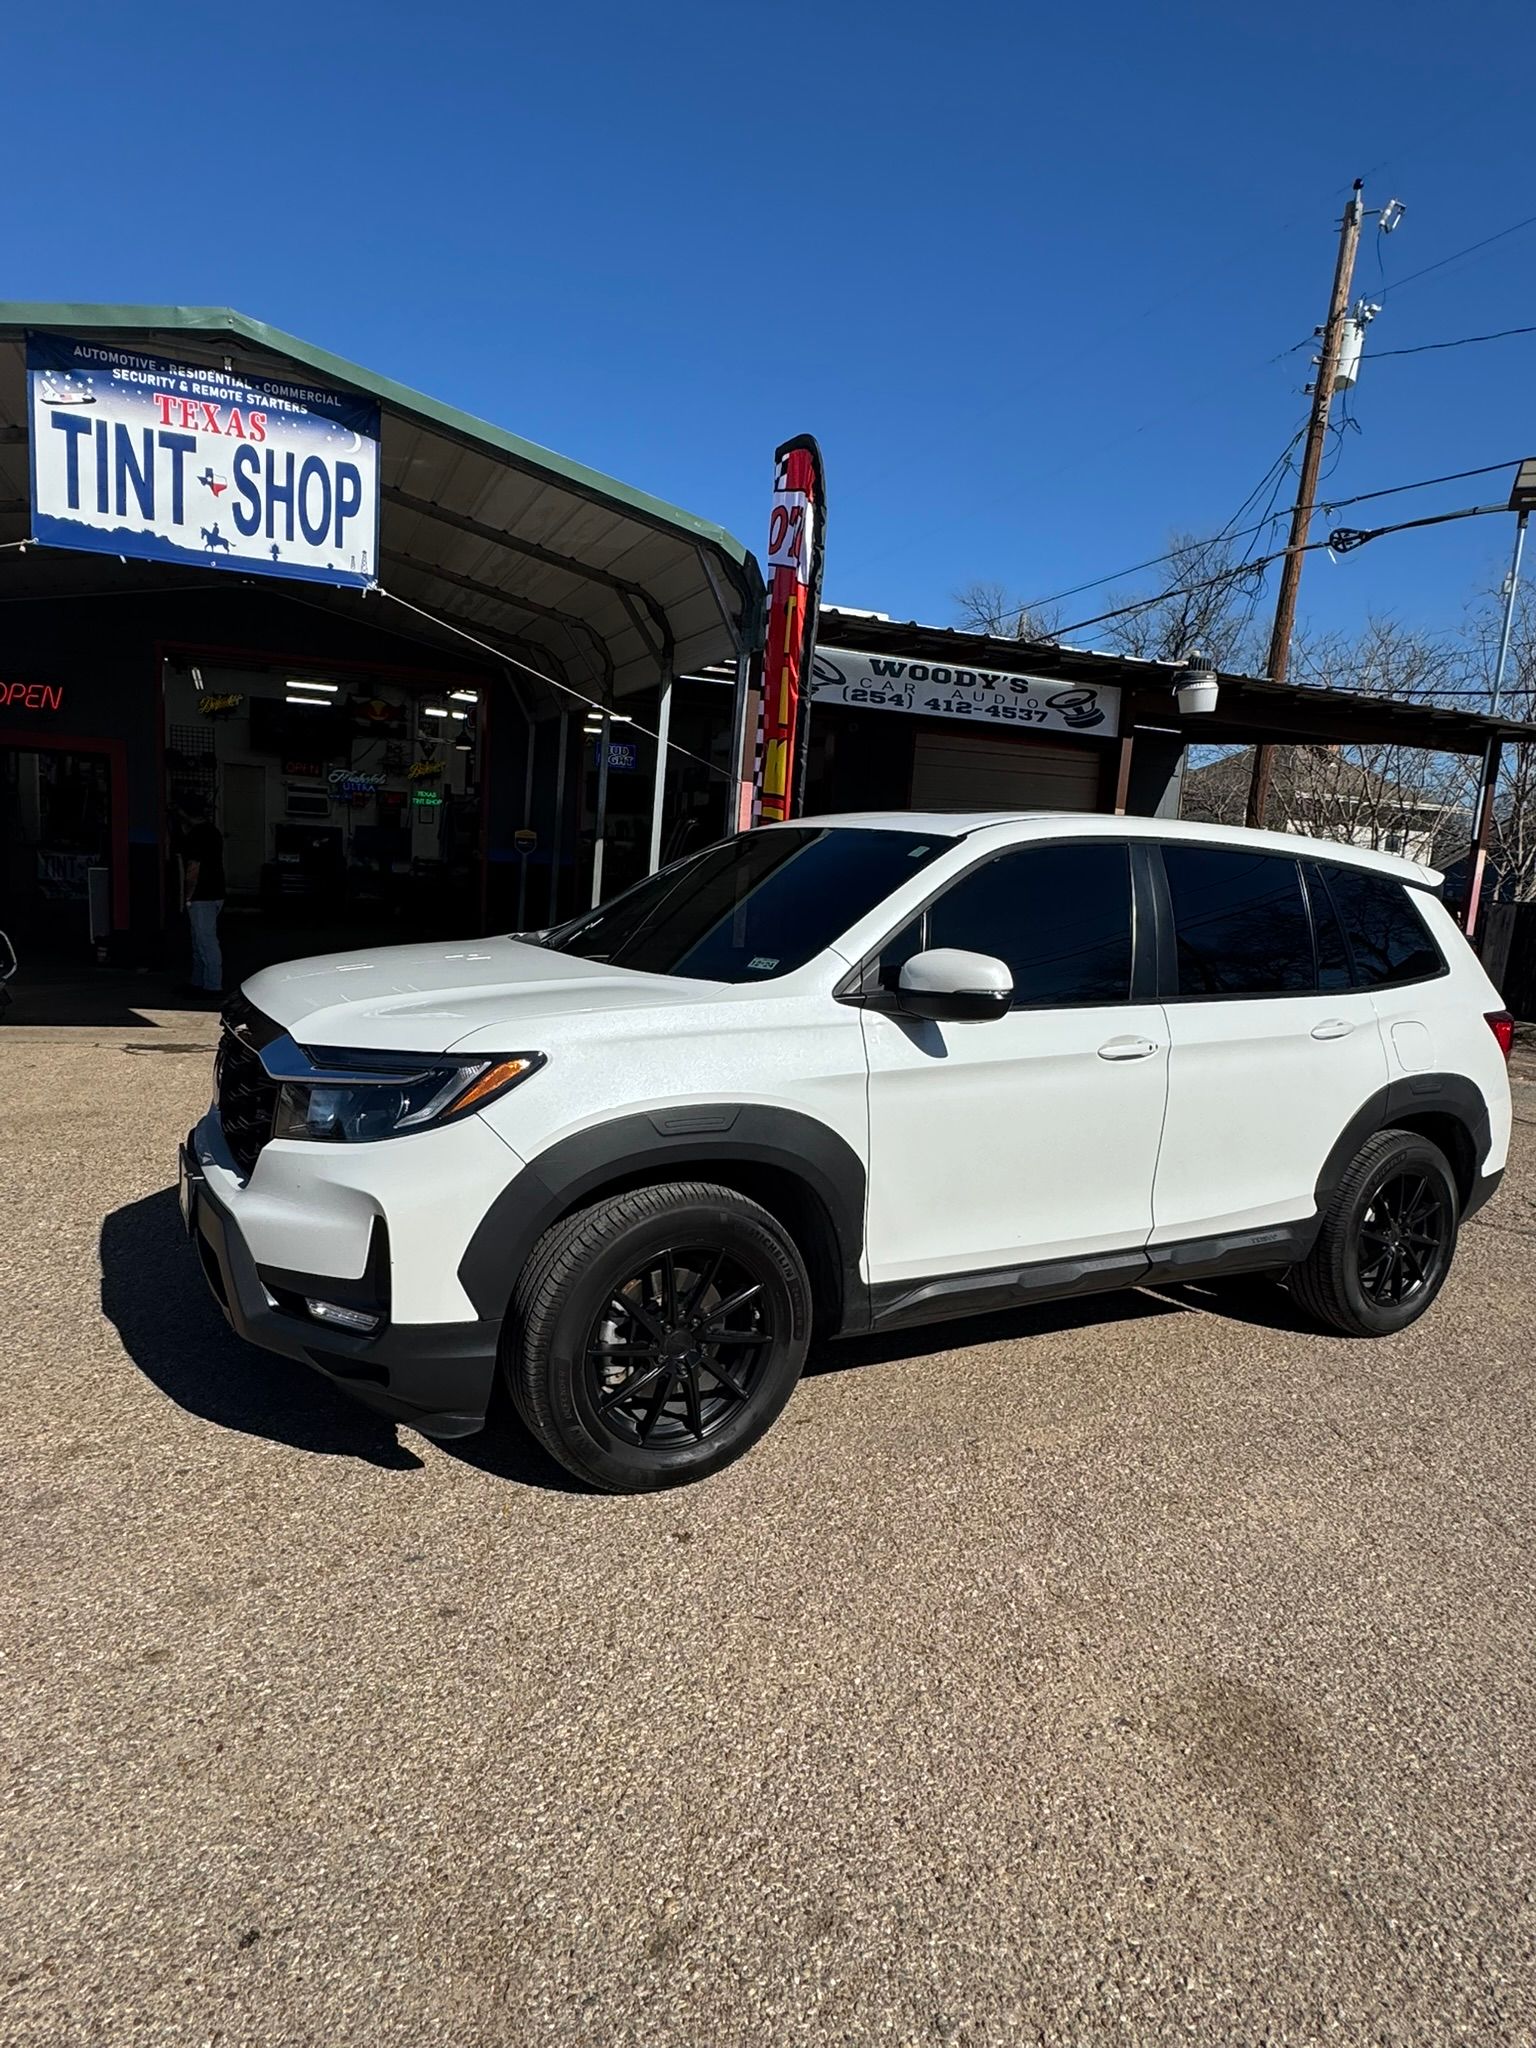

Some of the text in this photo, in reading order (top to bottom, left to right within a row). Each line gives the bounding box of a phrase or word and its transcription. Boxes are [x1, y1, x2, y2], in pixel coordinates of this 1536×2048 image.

[73, 345, 341, 407] AUTOMOTIVE RESIDENTIAL COMMERCIAL
[112, 368, 309, 415] SECURITY & REMOTE STARTERS
[153, 392, 268, 443] TEXAS
[50, 410, 362, 549] TINT SHOP
[860, 677, 1038, 709] CAR AUDIO
[868, 658, 1030, 694] WOODY'S
[842, 684, 1049, 723] (254) 412-4537
[603, 755, 634, 767] GHT
[606, 745, 630, 757] UD
[417, 790, 437, 798] TEXAS
